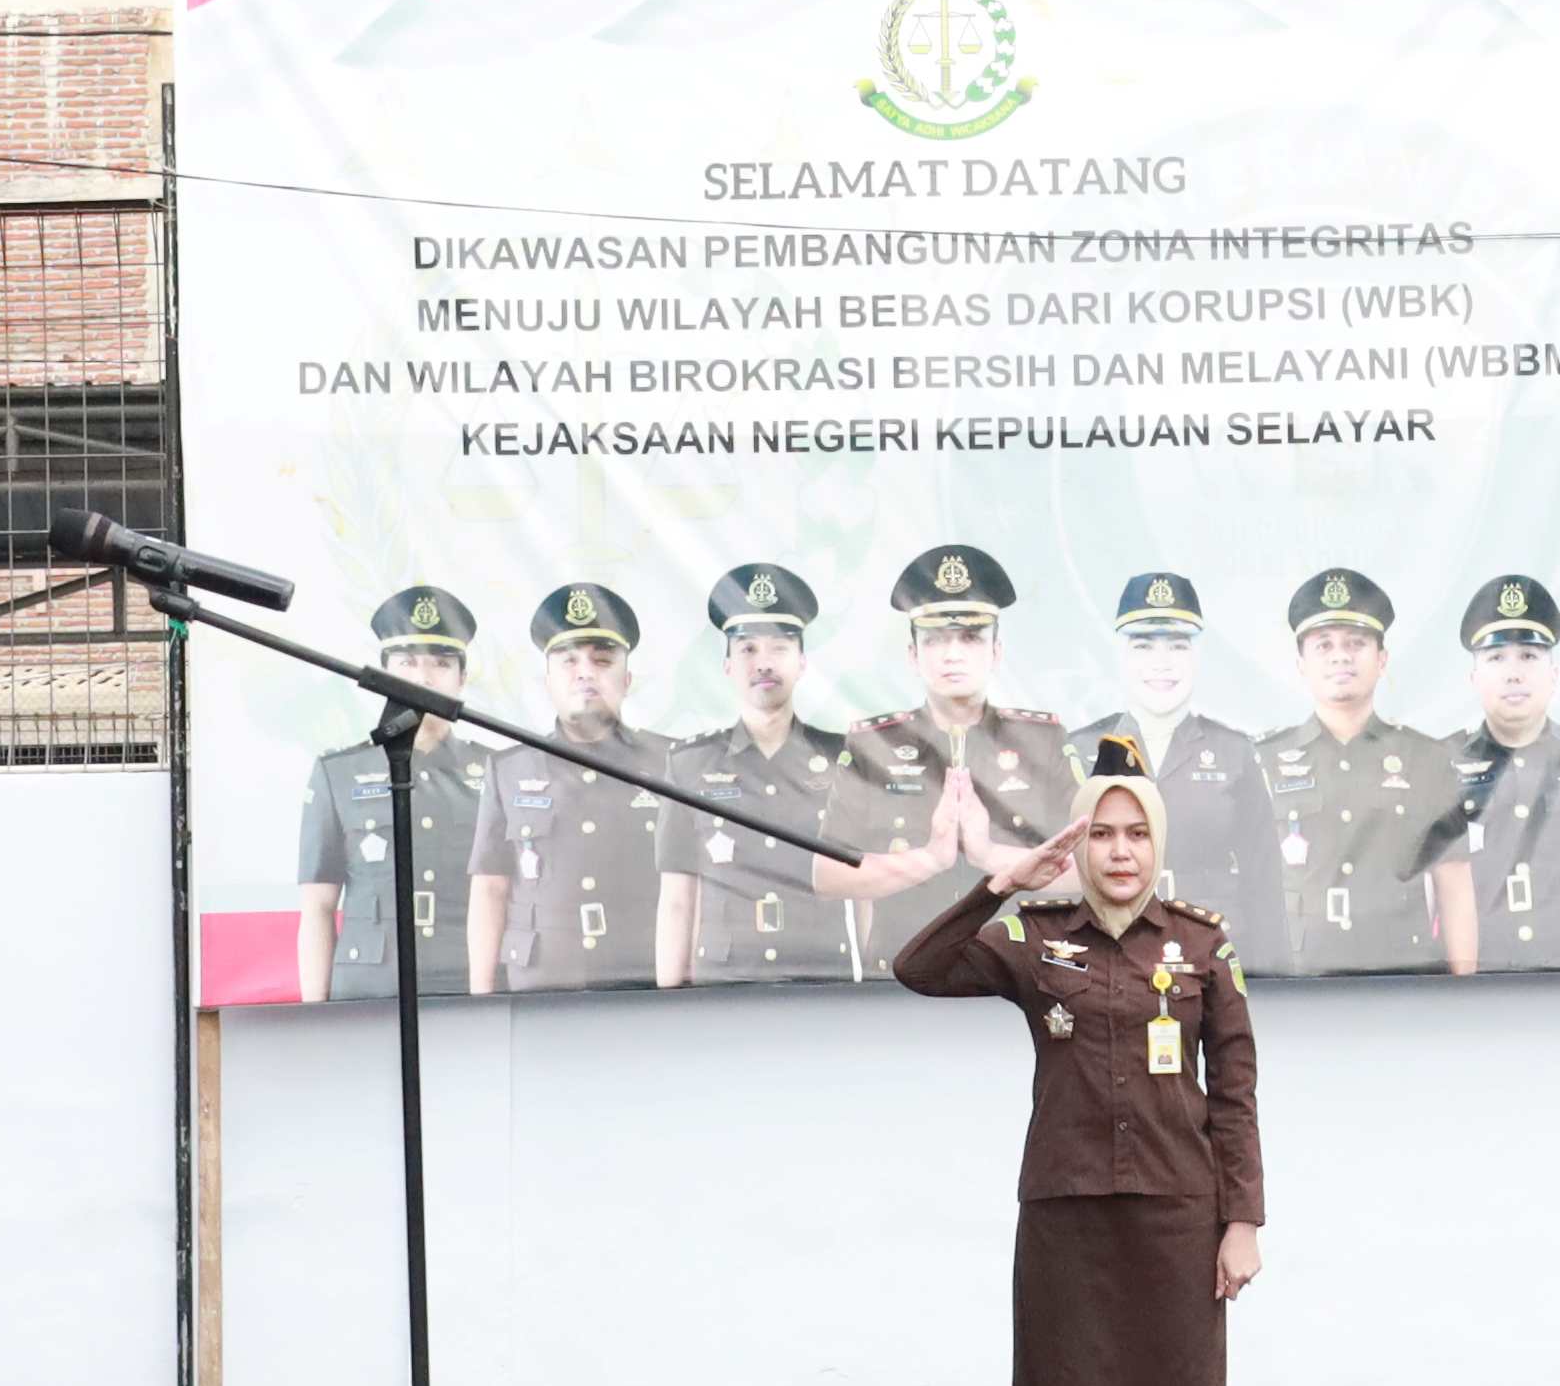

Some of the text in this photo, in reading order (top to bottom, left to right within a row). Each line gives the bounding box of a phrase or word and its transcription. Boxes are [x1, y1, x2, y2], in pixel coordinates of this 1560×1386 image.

[704, 159, 949, 201] SELAMAT
[962, 156, 1188, 197] DATANG
[413, 221, 1475, 271] DIKAWASAN PEMBANGUNAN ZONA INTEGRITAS
[418, 283, 1474, 332] MENUJU WILAYAH BEBAS DARI KORUPSI (WBK)
[299, 361, 392, 395] DAN
[407, 359, 613, 394] WILAYAH
[629, 356, 876, 393] BIROKRASI
[892, 353, 1057, 390] BERSIH
[1072, 353, 1165, 387] DAN
[1181, 347, 1409, 385] MELAYANI
[462, 408, 1436, 456] KEJAKSAAN NEGERI KEPULAUAN SELAYAR
